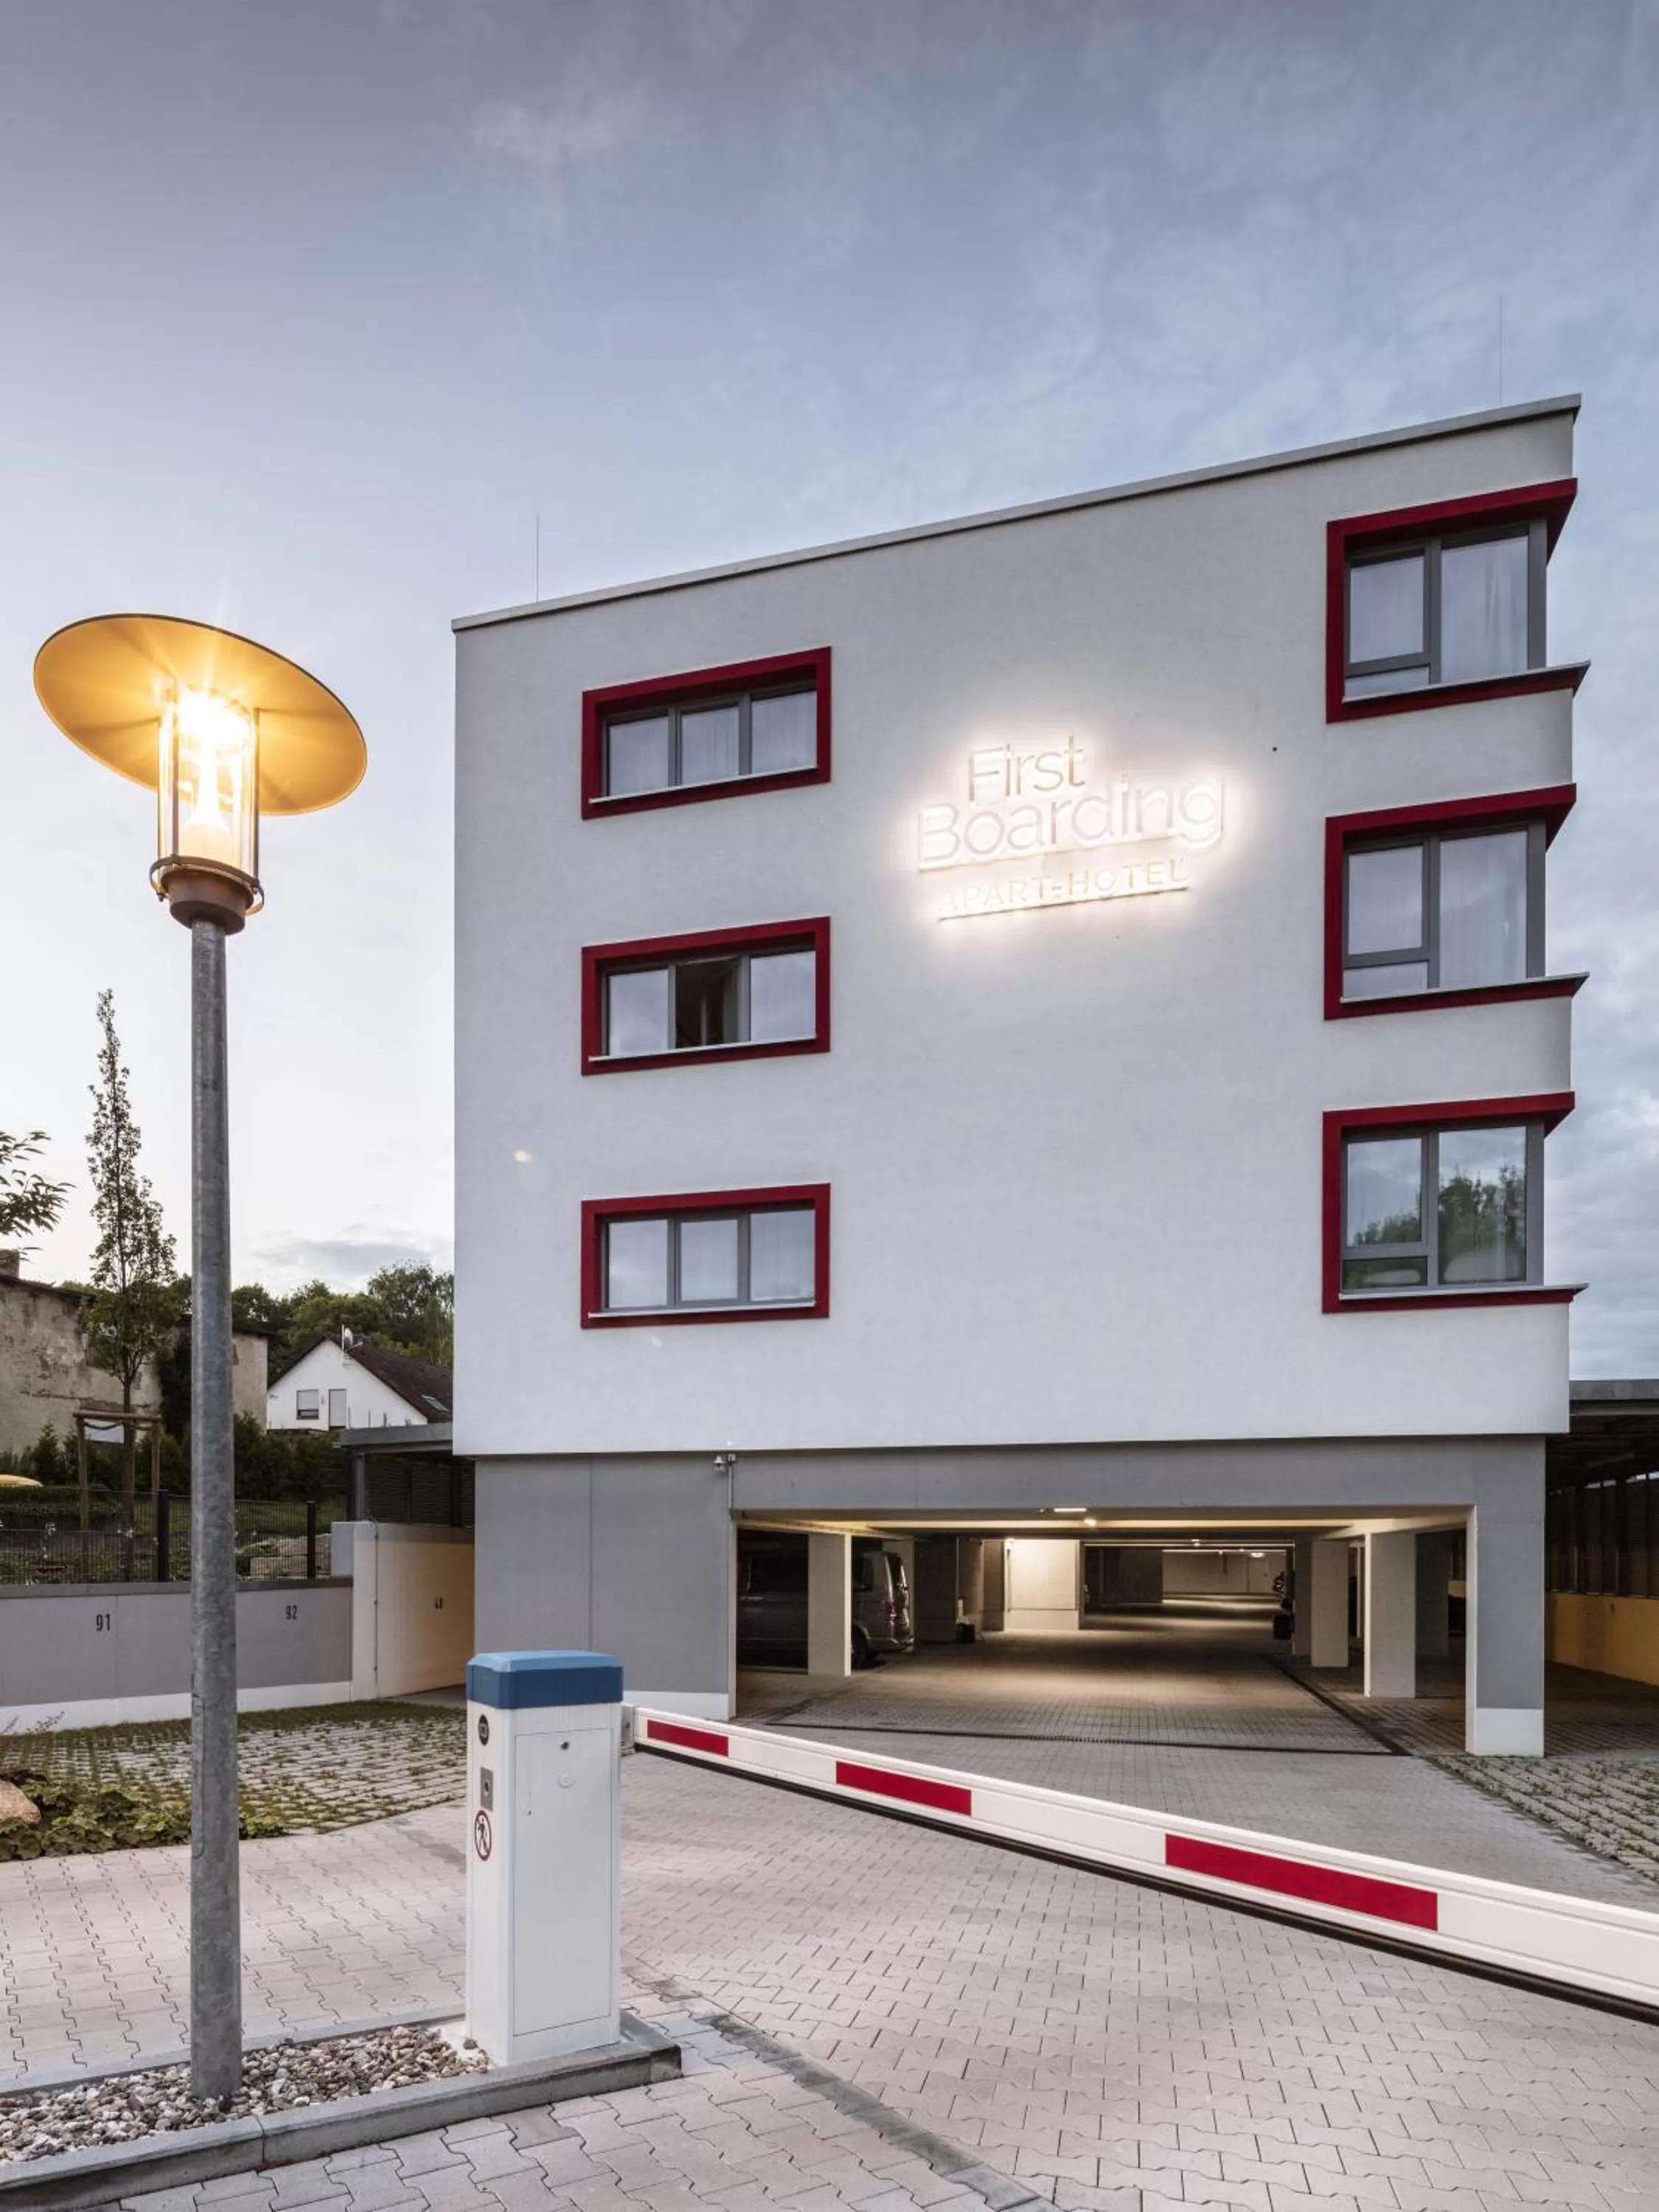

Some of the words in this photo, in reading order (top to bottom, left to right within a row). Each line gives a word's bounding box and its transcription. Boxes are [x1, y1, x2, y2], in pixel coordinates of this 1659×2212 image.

[967, 731, 1085, 803] First
[918, 771, 1225, 863] Boarding
[96, 1613, 111, 1632] 91
[285, 1604, 298, 1620] 92
